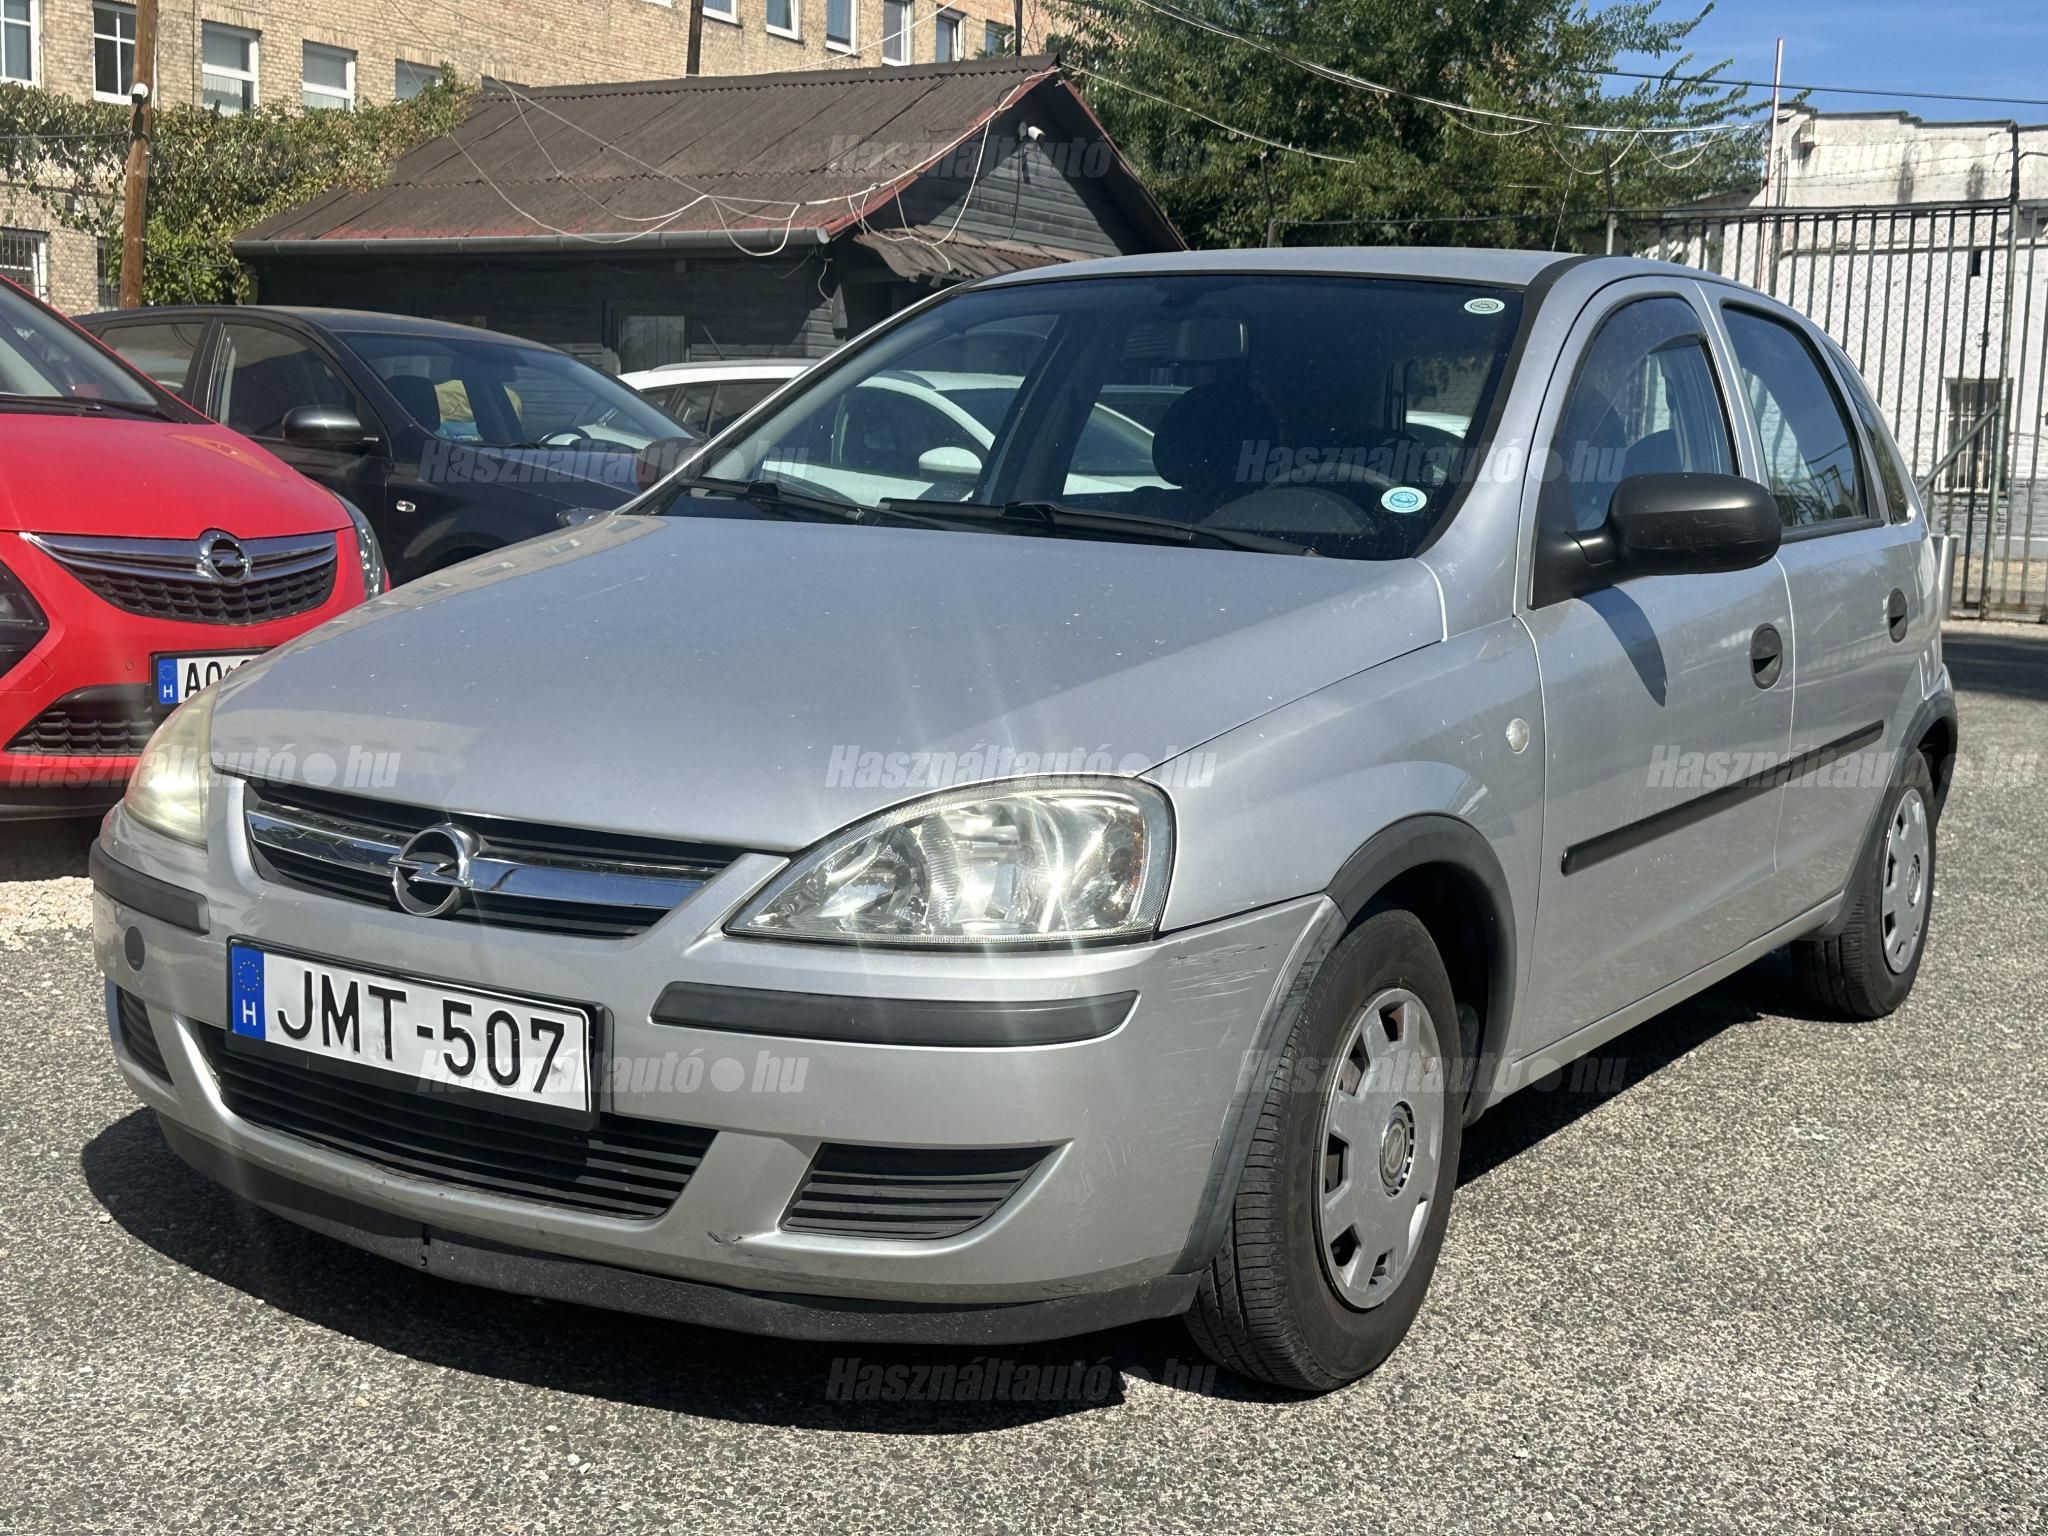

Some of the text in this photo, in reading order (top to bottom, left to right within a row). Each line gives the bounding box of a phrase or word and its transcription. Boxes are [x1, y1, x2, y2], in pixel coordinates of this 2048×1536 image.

[163, 684, 173, 698] H
[242, 999, 257, 1026] H
[277, 970, 565, 1093] JMT-507
